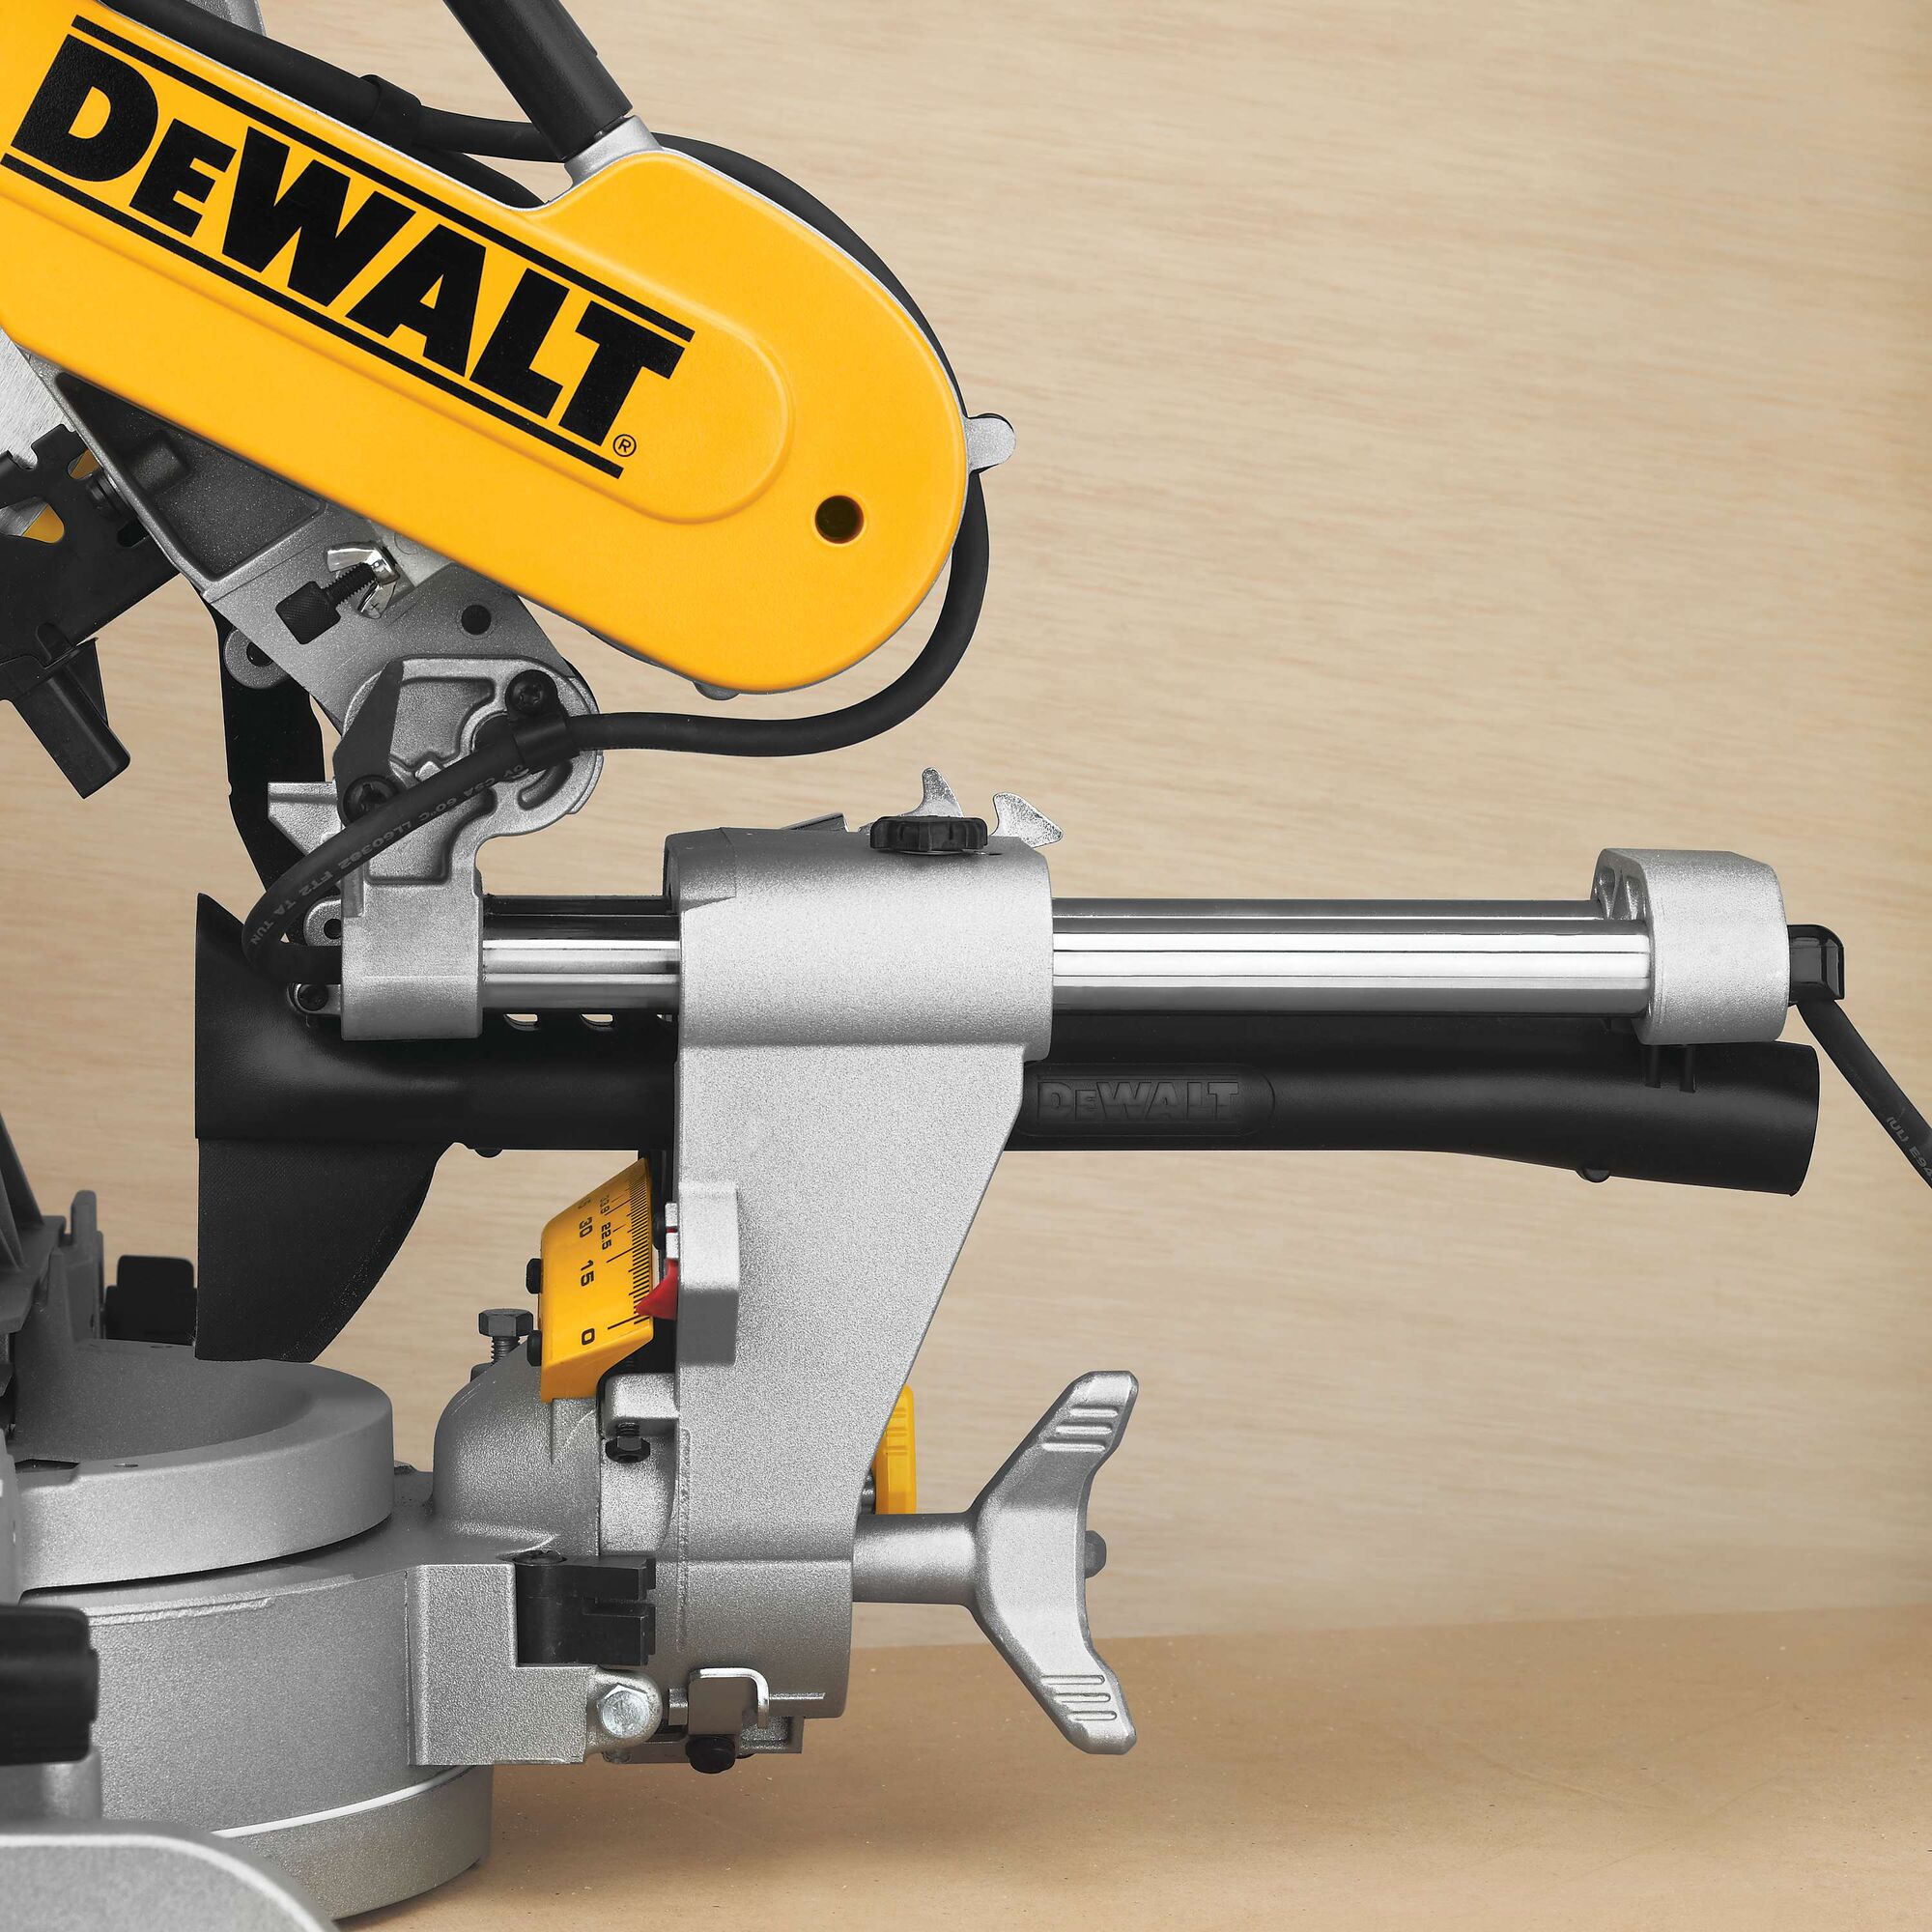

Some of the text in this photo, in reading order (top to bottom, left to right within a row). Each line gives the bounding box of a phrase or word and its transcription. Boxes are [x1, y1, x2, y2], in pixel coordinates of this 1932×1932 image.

[12, 34, 685, 446] DEWALT
[298, 870, 333, 896] FT2
[250, 920, 274, 945] TUN
[1037, 1081, 1239, 1122] DEWALT
[579, 1216, 593, 1238] 30
[601, 1221, 612, 1250] 22.5
[581, 1259, 595, 1287] 15
[581, 1327, 596, 1346] 0
